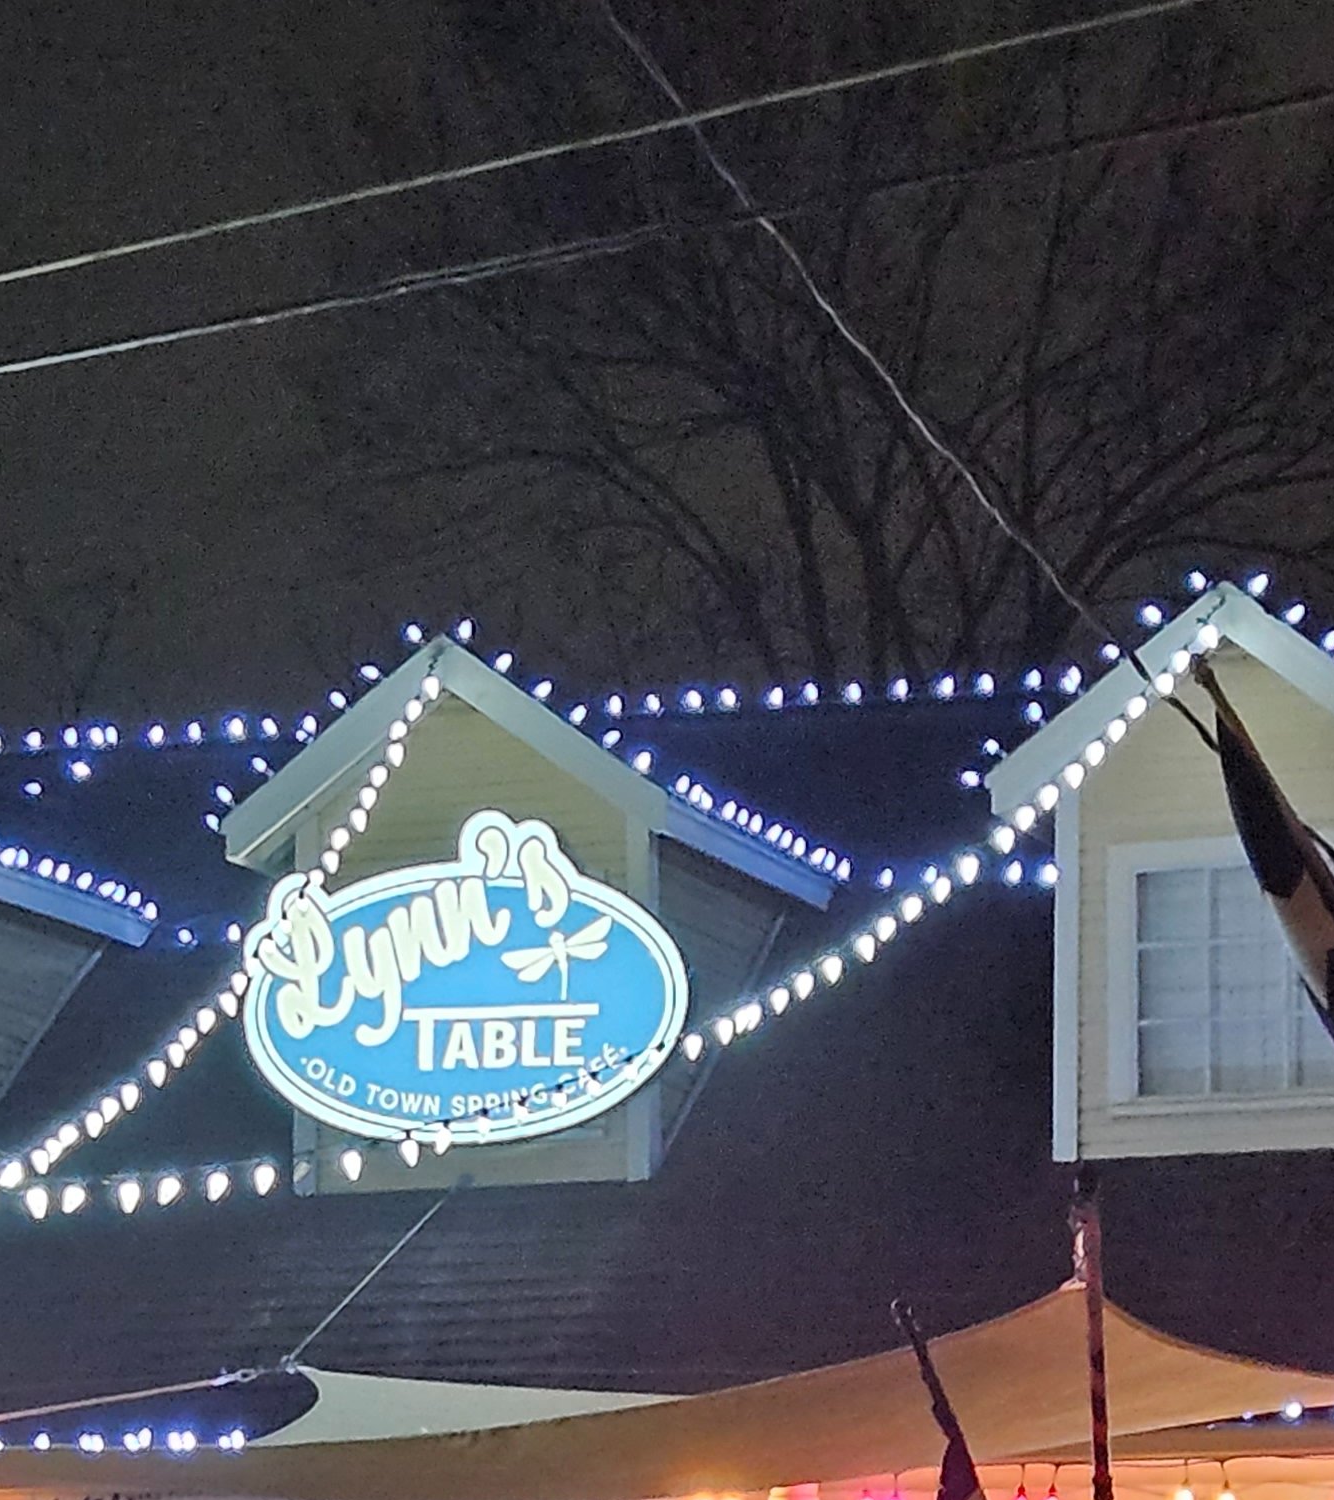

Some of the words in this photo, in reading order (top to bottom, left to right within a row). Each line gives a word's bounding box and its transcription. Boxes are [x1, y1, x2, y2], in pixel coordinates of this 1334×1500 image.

[260, 827, 570, 1046] Lynn's
[401, 1004, 599, 1071] TABLE
[307, 1057, 356, 1098] OLD
[367, 1084, 440, 1116] TOWN
[451, 1084, 547, 1116] SPRING
